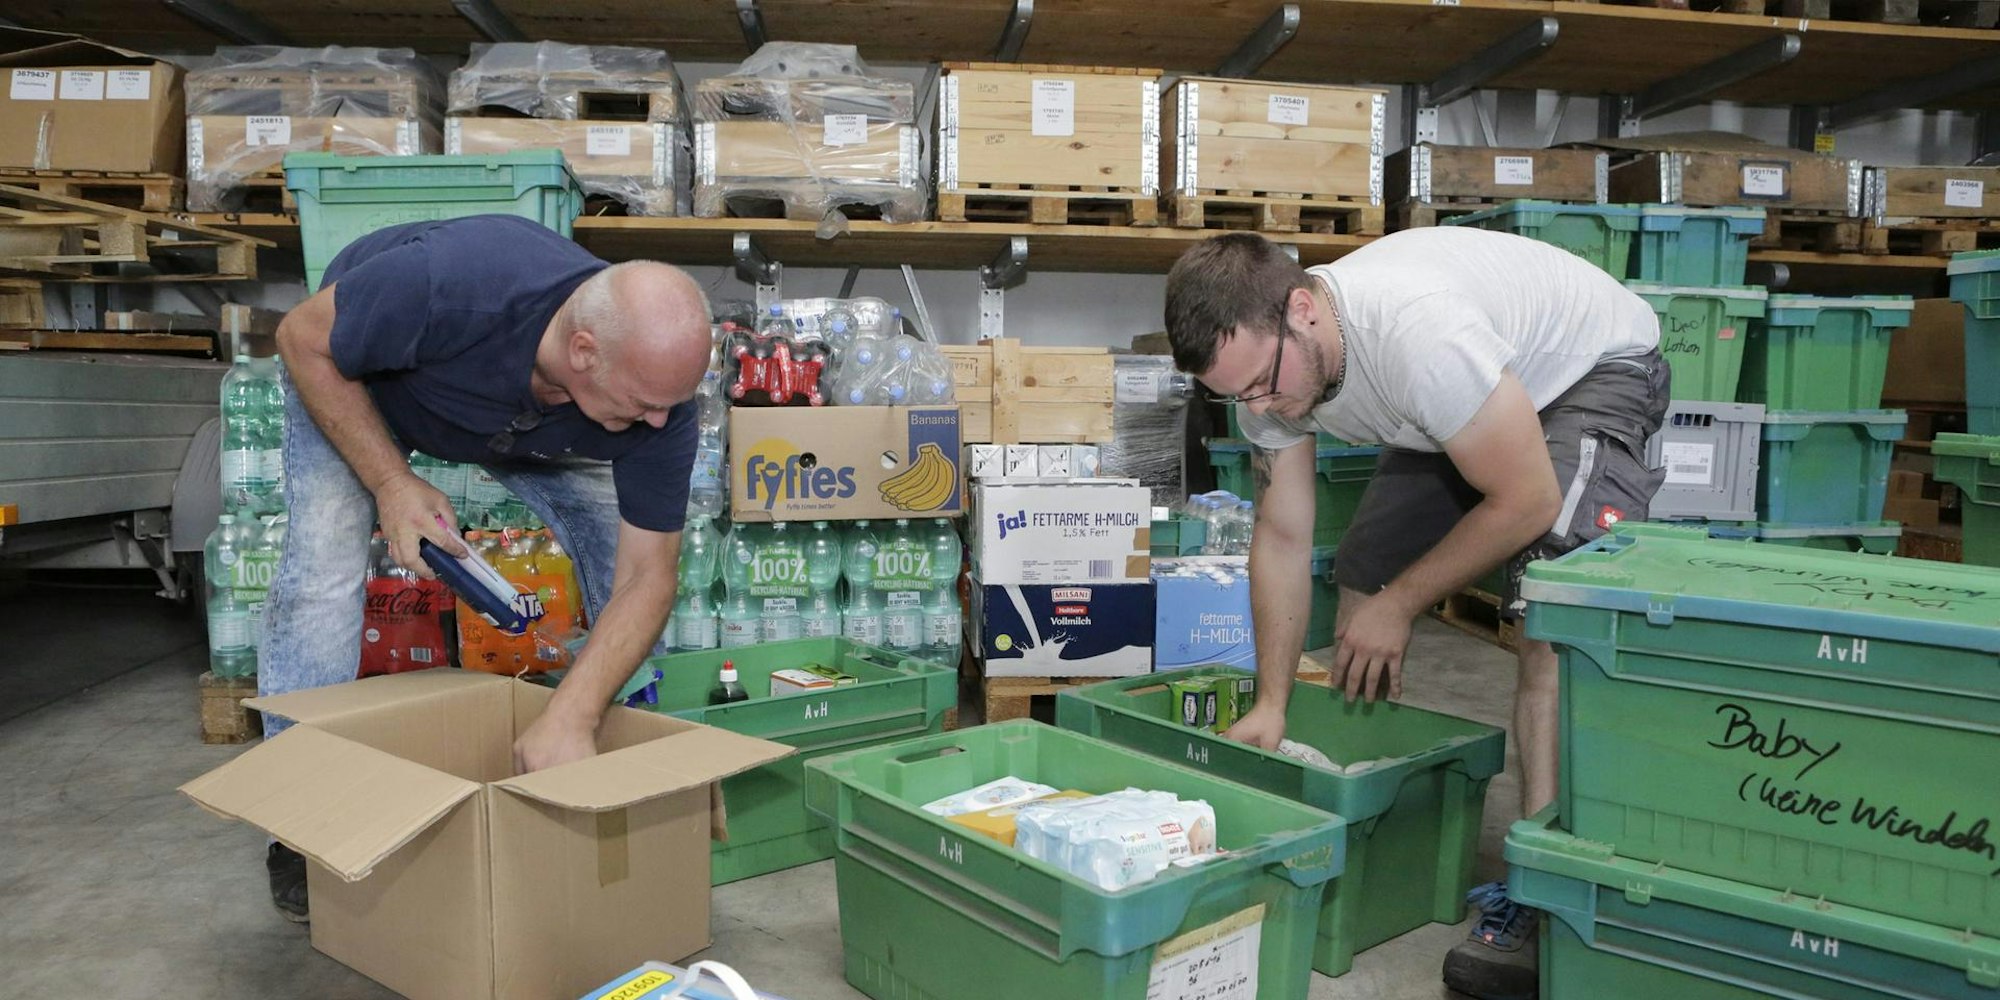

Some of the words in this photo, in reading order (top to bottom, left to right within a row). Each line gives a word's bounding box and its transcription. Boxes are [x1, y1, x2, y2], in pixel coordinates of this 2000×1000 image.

[1663, 337, 1701, 356] Lotion
[911, 414, 957, 425] Bananas
[997, 510, 1028, 540] ja!
[1033, 512, 1090, 527] FETTARME
[1095, 512, 1140, 526] H-MILCH
[1089, 528, 1109, 537] Fett
[749, 557, 808, 584] 100%
[874, 551, 932, 577] 100%
[1054, 589, 1089, 599] MILSANI
[1050, 616, 1092, 626] Vollmilch
[1199, 612, 1243, 626] fettarme
[1190, 628, 1251, 644] H-MILCH
[1707, 703, 1842, 781] Baby
[1125, 843, 1163, 857] SENSITIVE
